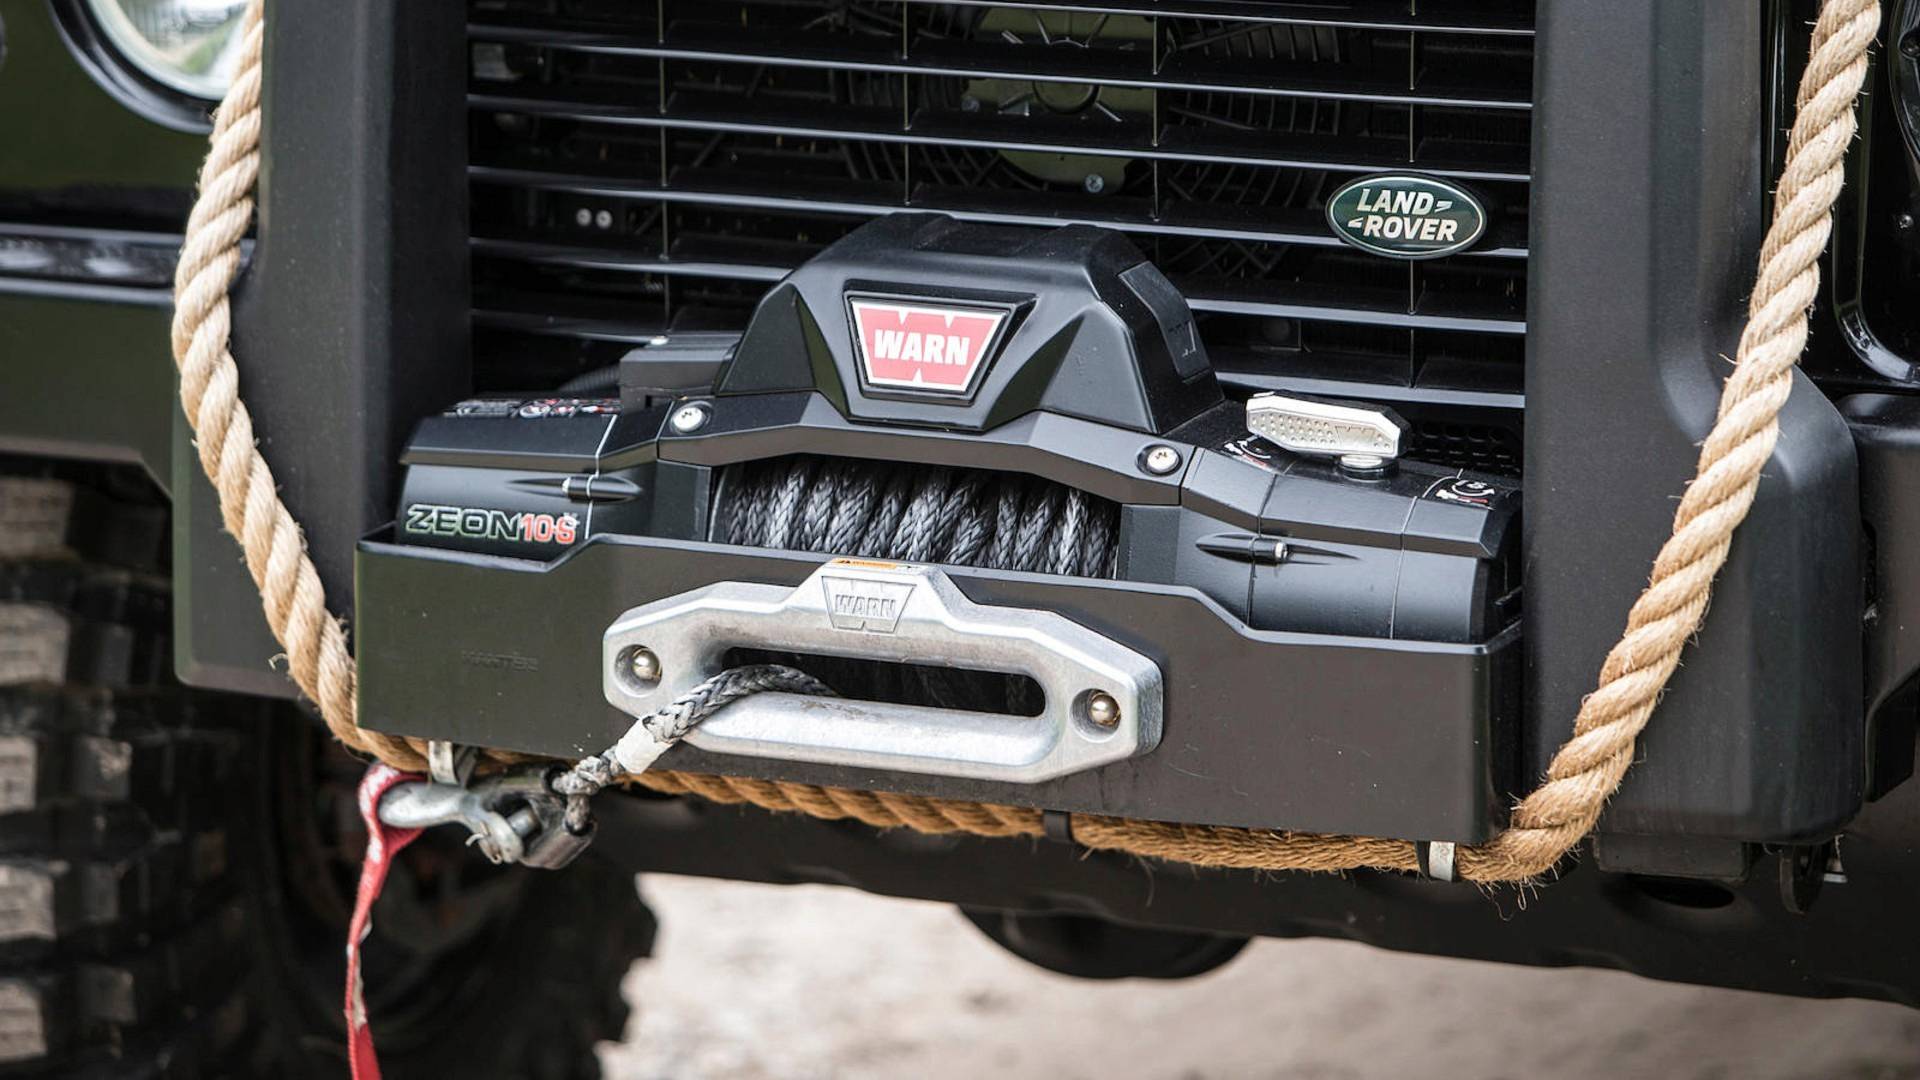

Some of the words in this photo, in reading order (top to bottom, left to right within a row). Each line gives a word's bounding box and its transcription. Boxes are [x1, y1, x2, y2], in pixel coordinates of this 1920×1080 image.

[1357, 188, 1434, 215] LAND
[1363, 215, 1458, 241] ROVER
[874, 329, 970, 366] WARN
[834, 594, 896, 617] WARN
